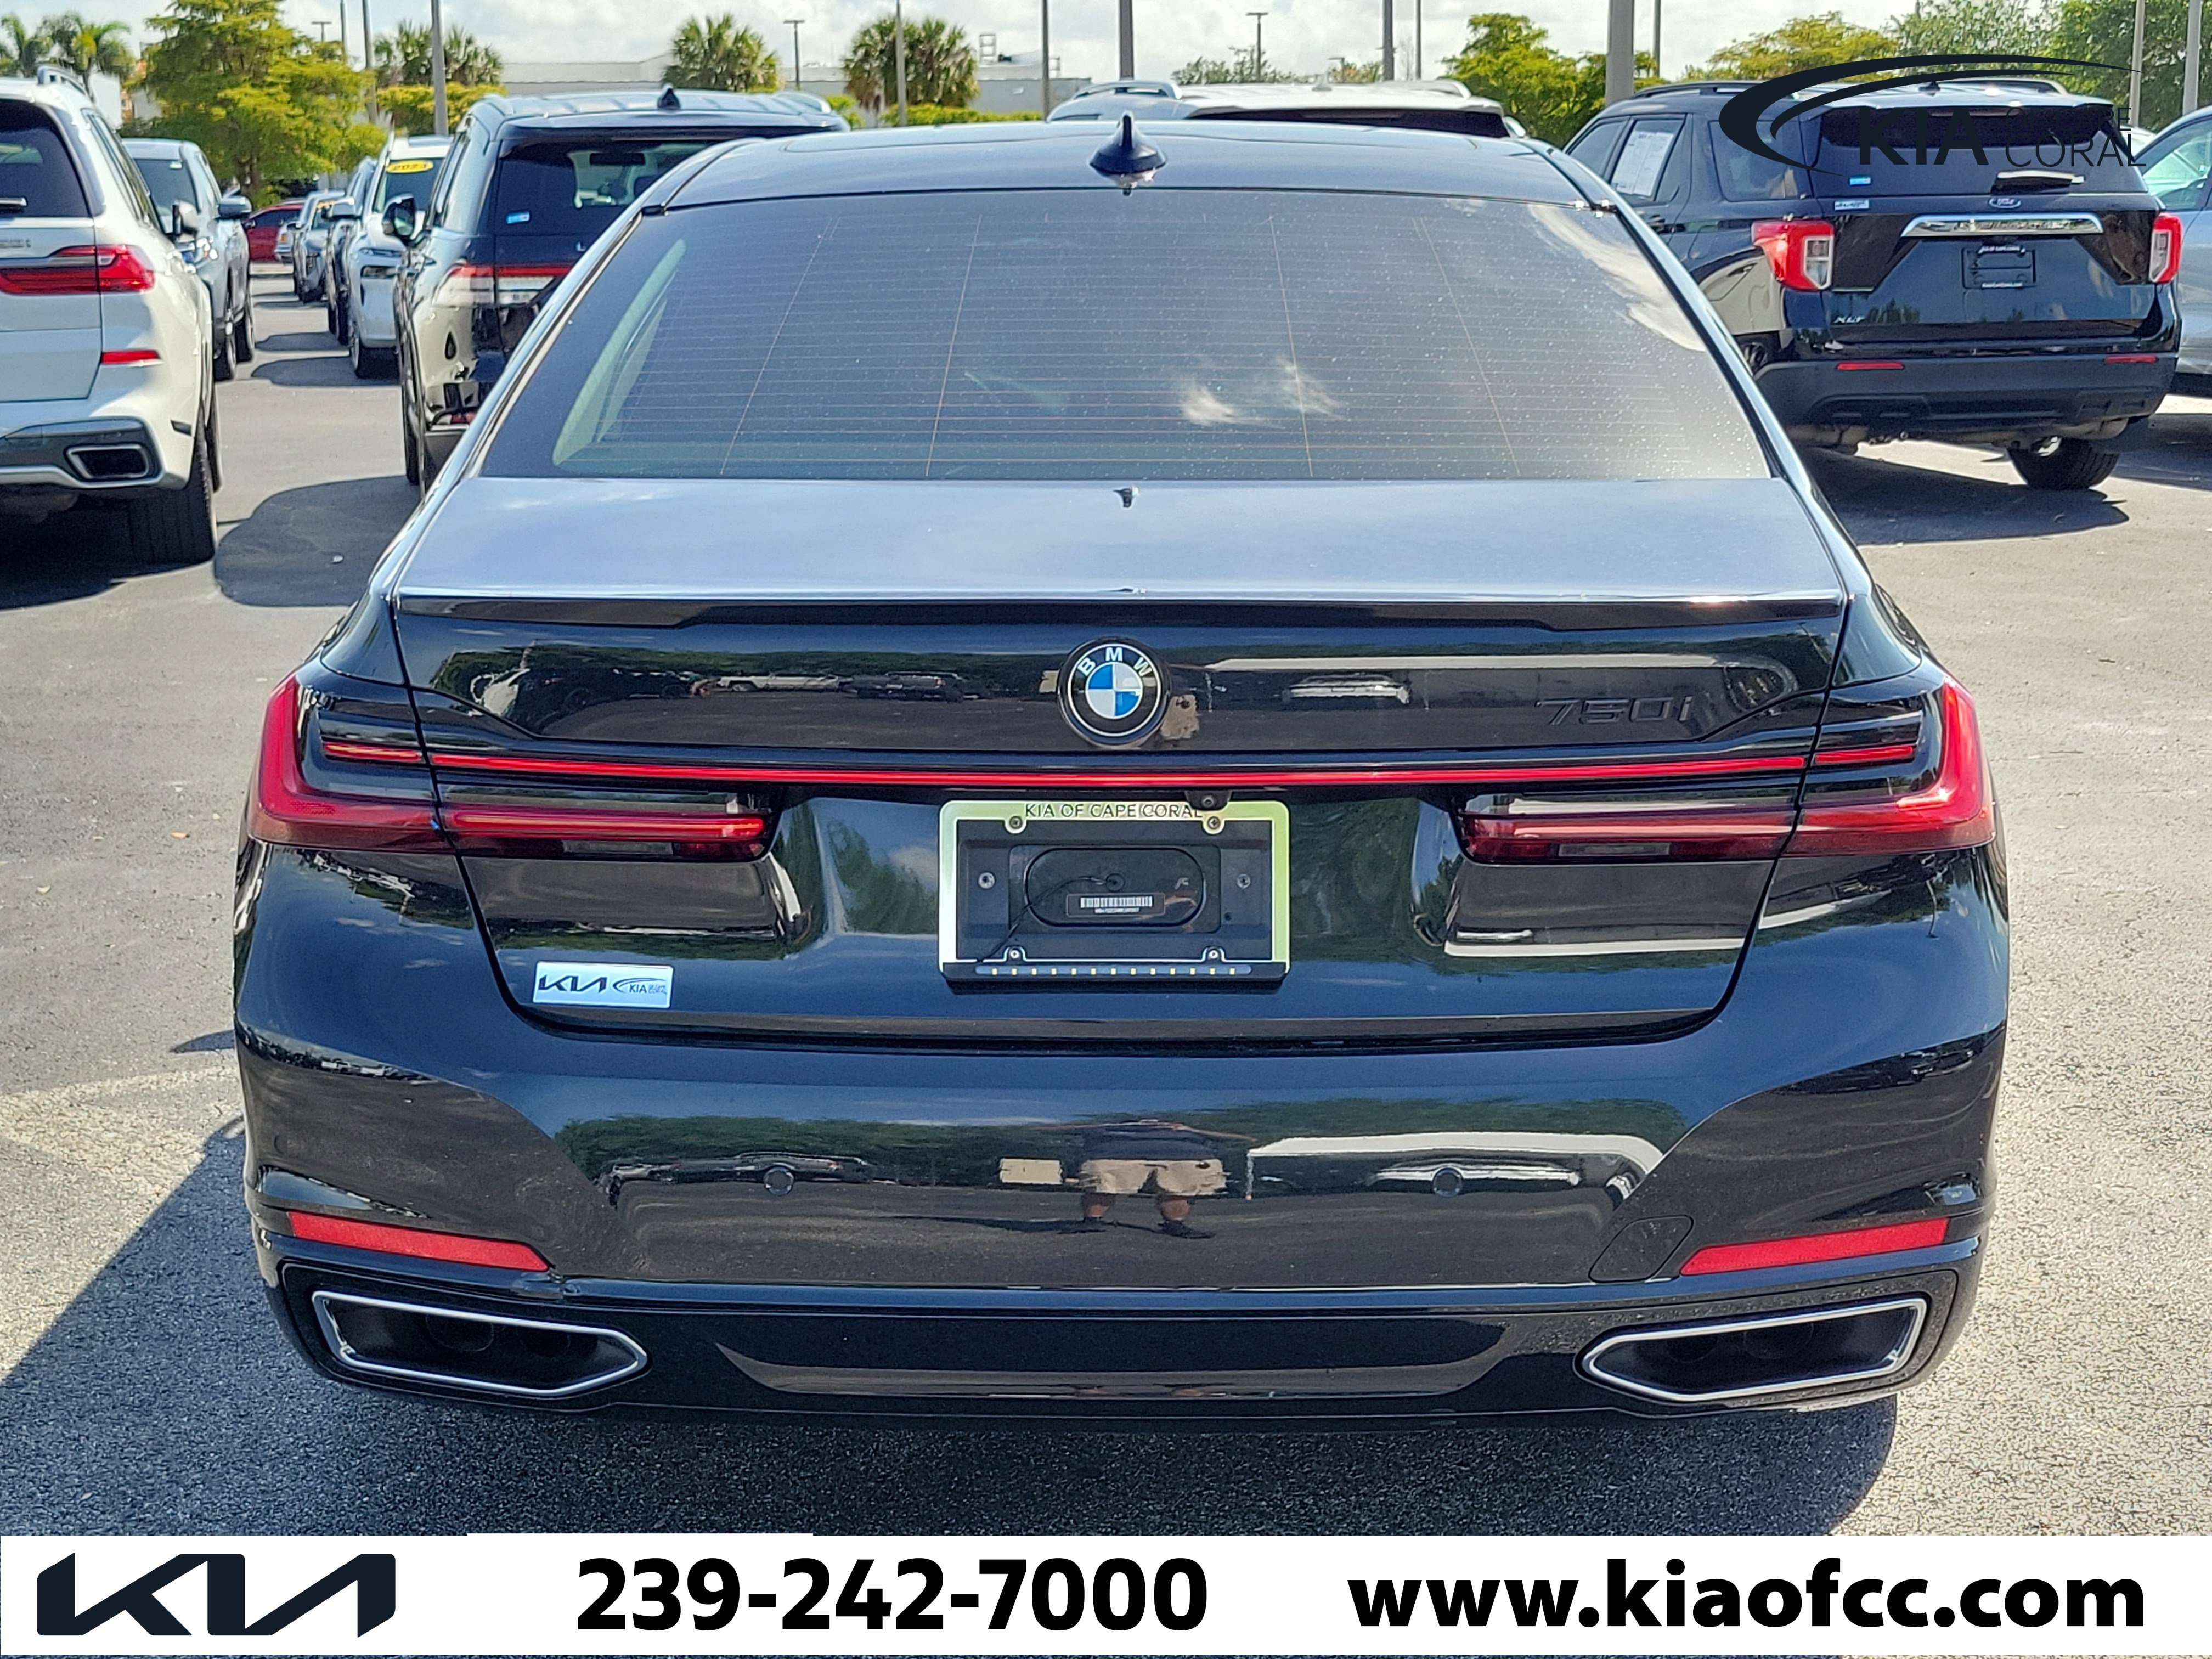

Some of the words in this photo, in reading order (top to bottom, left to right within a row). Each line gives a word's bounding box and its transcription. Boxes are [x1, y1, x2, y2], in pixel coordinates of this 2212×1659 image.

[1077, 647, 1153, 677] BMW
[1535, 696, 1693, 726] 750i
[1025, 803, 1055, 817] KIA
[1060, 803, 1084, 817] OF
[1090, 803, 1136, 817] CAPE
[629, 984, 647, 994] KIA
